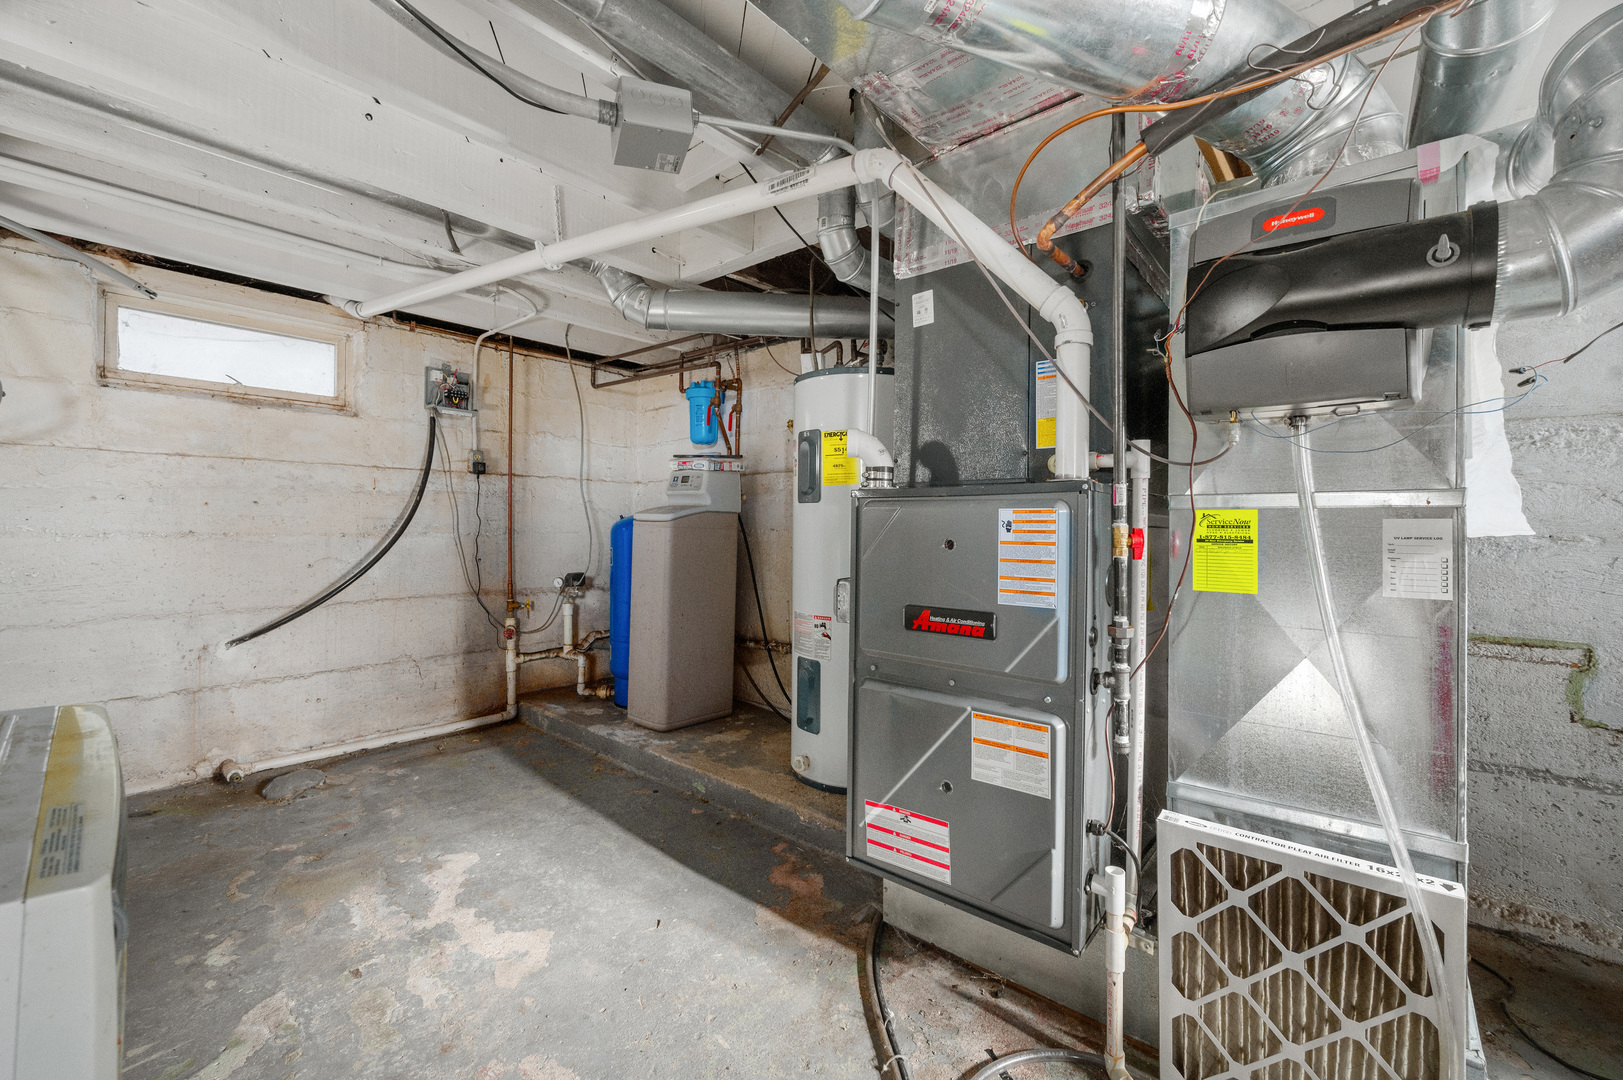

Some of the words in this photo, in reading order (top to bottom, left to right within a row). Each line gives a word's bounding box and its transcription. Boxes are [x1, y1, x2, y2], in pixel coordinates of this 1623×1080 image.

[1259, 130, 1280, 142] 11/19
[1272, 212, 1314, 226] Honeywell
[912, 610, 985, 637] Amana
[1234, 832, 1286, 848] CONTRACTOR
[1288, 846, 1313, 855] PLEAT
[1332, 857, 1361, 867] FILTER
